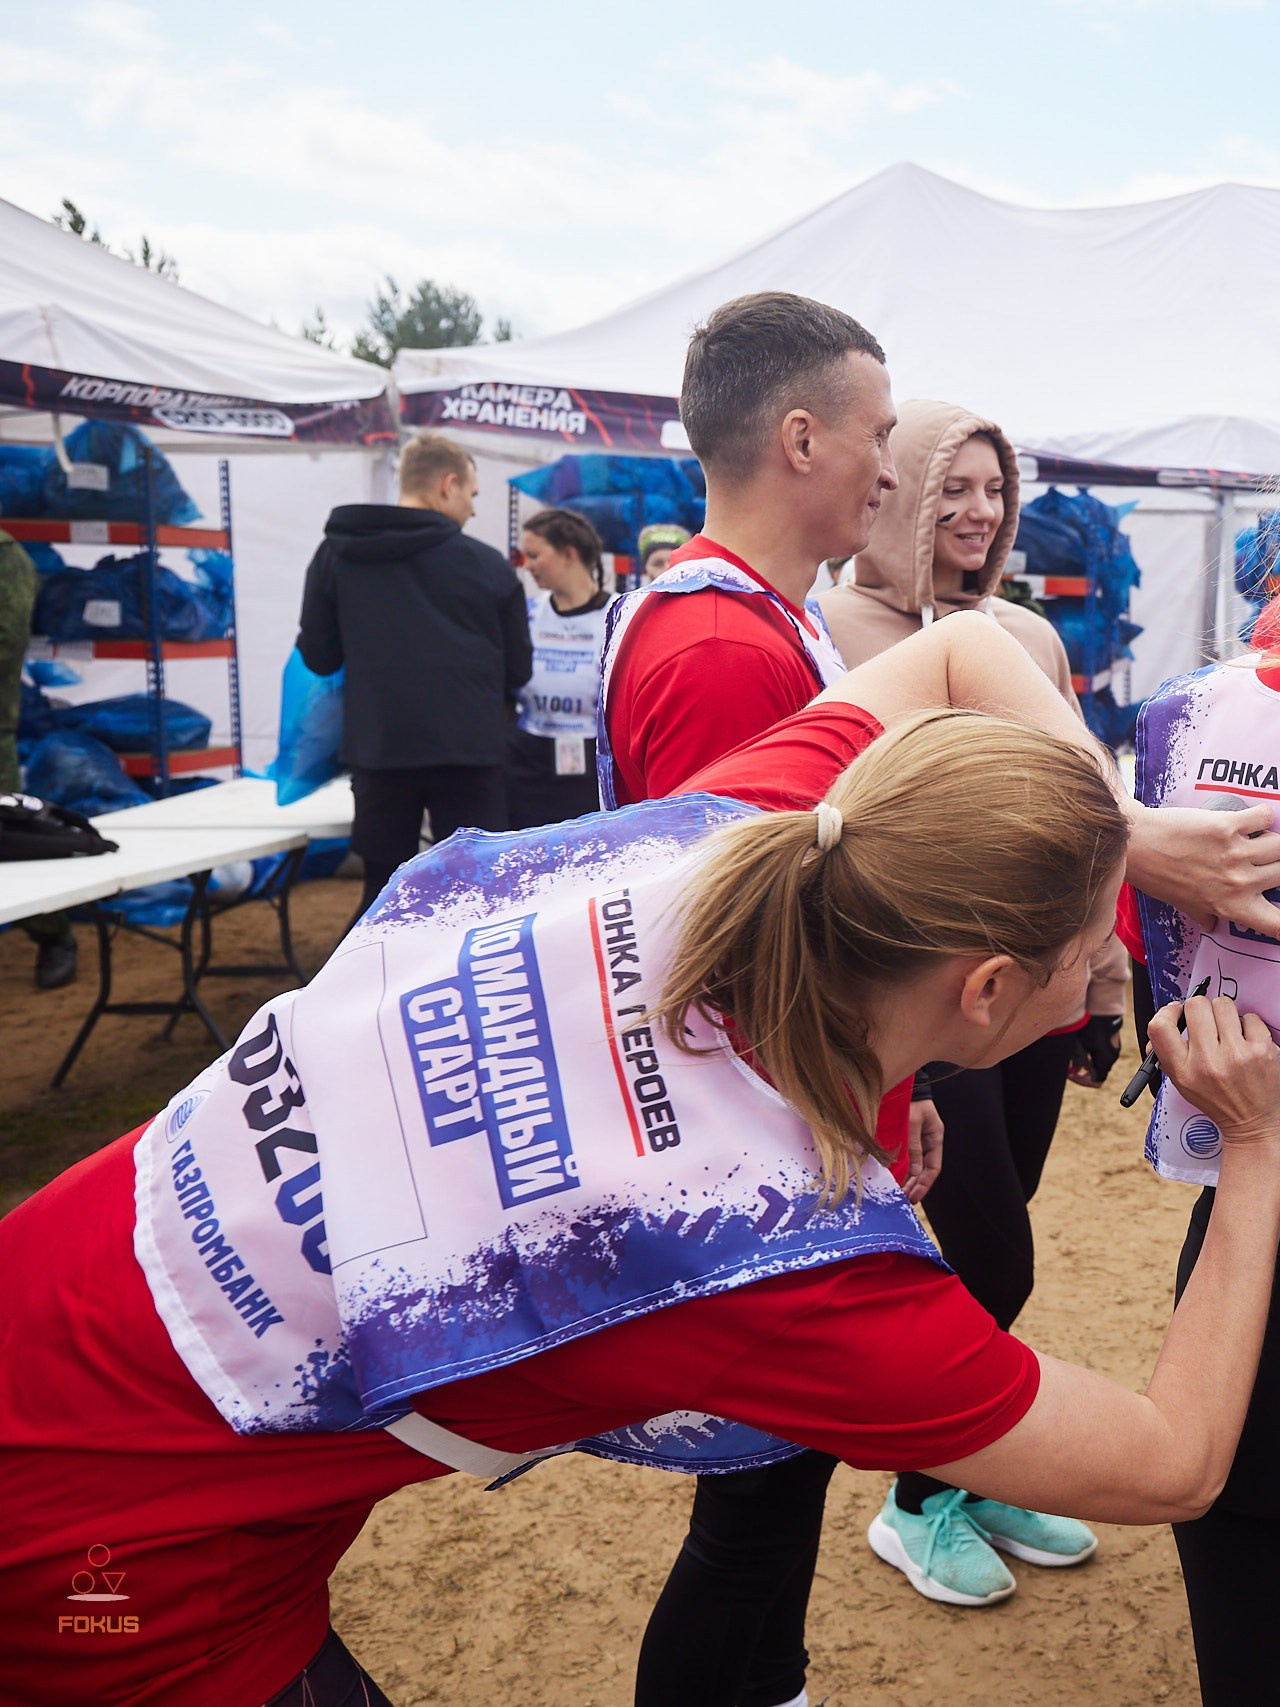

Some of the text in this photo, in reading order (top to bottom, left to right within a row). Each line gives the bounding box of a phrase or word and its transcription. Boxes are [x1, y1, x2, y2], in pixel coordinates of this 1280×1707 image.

[441, 397, 588, 435] ХРАНЕНИЯ
[461, 382, 574, 411] КАМЕРА
[1197, 758, 1279, 790] ГОНКА
[406, 985, 485, 1130] СТАРТ
[468, 917, 580, 1200] КОМАНДНЫЙ
[601, 887, 682, 1154] ГОНКА ГЕРОЕВ
[171, 1138, 286, 1339] ГАЗПРОМБАНК
